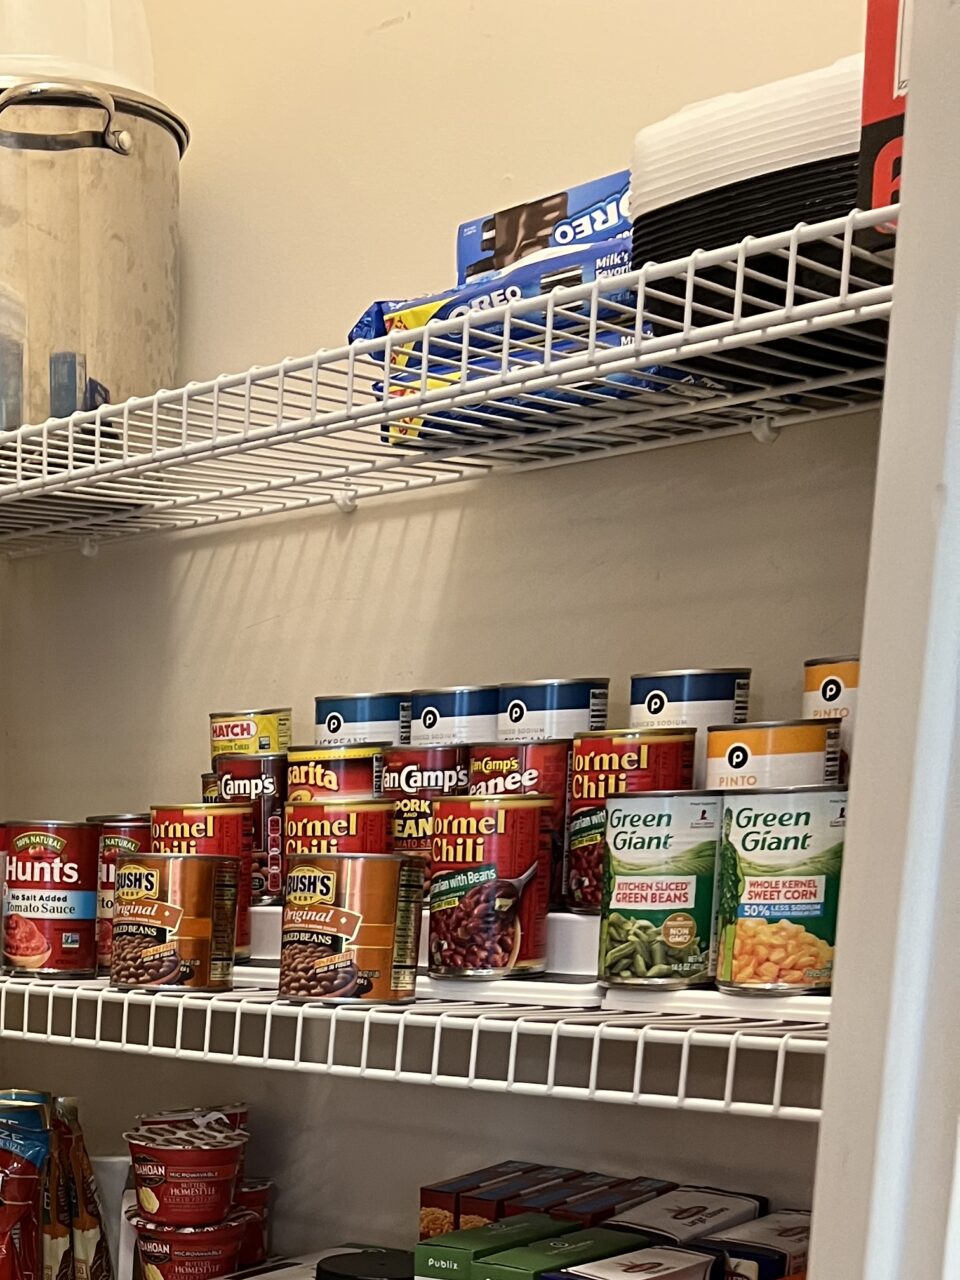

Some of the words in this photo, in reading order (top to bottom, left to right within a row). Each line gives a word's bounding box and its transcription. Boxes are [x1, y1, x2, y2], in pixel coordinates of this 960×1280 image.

[595, 252, 629, 270] Milk's
[446, 285, 522, 338] OREO
[812, 707, 850, 718] PINTO
[212, 722, 251, 738] HATCH
[481, 756, 520, 774] Camp's
[399, 764, 469, 794] Camp's
[719, 775, 758, 787] PINTO
[220, 773, 276, 800] Camp's
[610, 808, 672, 828] Green
[736, 807, 811, 829] Green
[30, 834, 62, 850] NATURAL
[105, 837, 137, 851] NATURAL
[613, 831, 674, 851] Giant
[741, 830, 813, 852] Giant
[432, 837, 485, 863] Chili
[448, 873, 468, 886] with
[467, 868, 497, 884] Beans
[617, 881, 654, 892] KITCHEN
[654, 881, 689, 891] SLICED
[748, 880, 781, 890] WHOLE
[781, 879, 818, 890] KERNEL
[11, 893, 20, 902] No
[21, 893, 37, 902] Salt
[38, 893, 68, 903] Added
[615, 892, 650, 903] GREEN
[649, 891, 689, 904] BEANS
[747, 890, 782, 901] SWEET
[783, 890, 818, 900] CORN
[5, 901, 40, 914] Tomato
[40, 902, 76, 914] Sauce
[743, 904, 770, 916] 50%
[127, 924, 157, 937] BEANS
[668, 927, 690, 936] NON
[300, 931, 333, 945] BEANS
[427, 1257, 458, 1270] Publix
